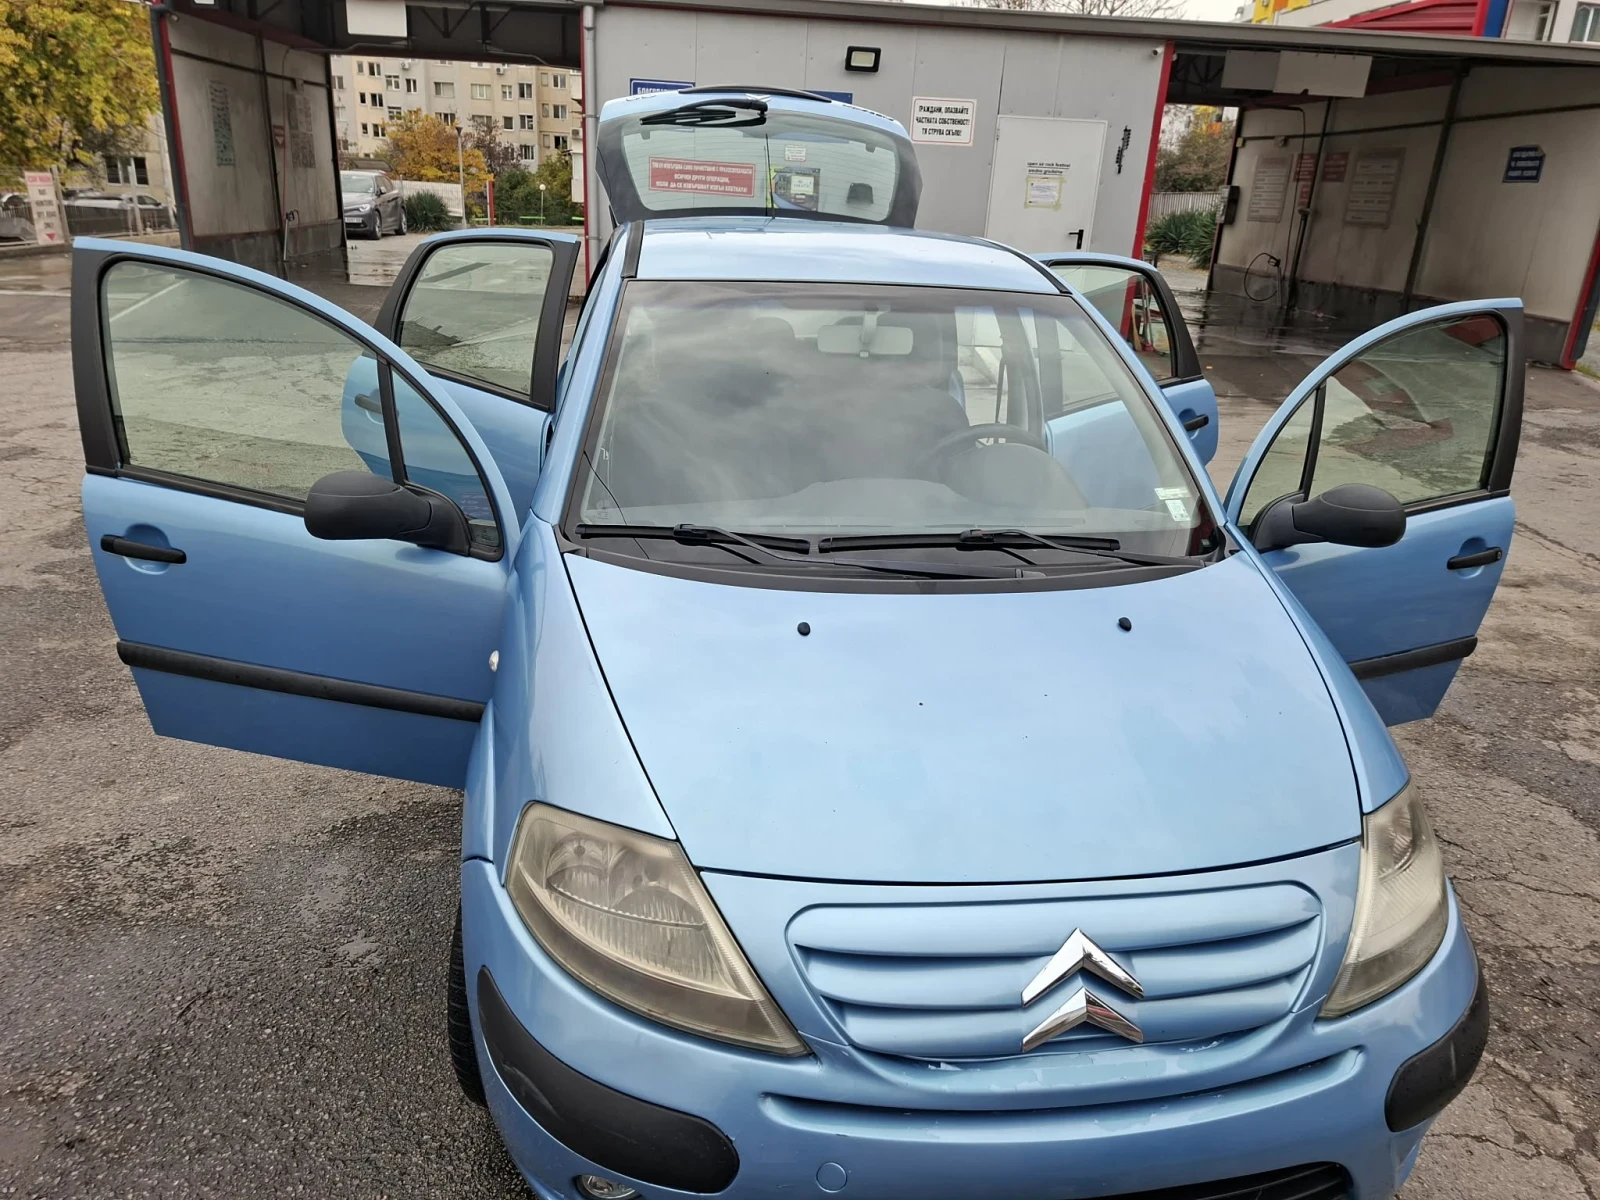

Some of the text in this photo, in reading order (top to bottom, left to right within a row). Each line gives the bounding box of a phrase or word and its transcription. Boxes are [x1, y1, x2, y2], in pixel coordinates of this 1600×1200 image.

[918, 105, 969, 115] ГРАЖДАНИ, ОПАЗВАЙТЕ
[916, 116, 938, 124] ЧАСТНАТА
[922, 127, 962, 137] ТЯ СТРУВА СКЪПО!
[683, 182, 710, 190] ИЗВЪРШВАТ
